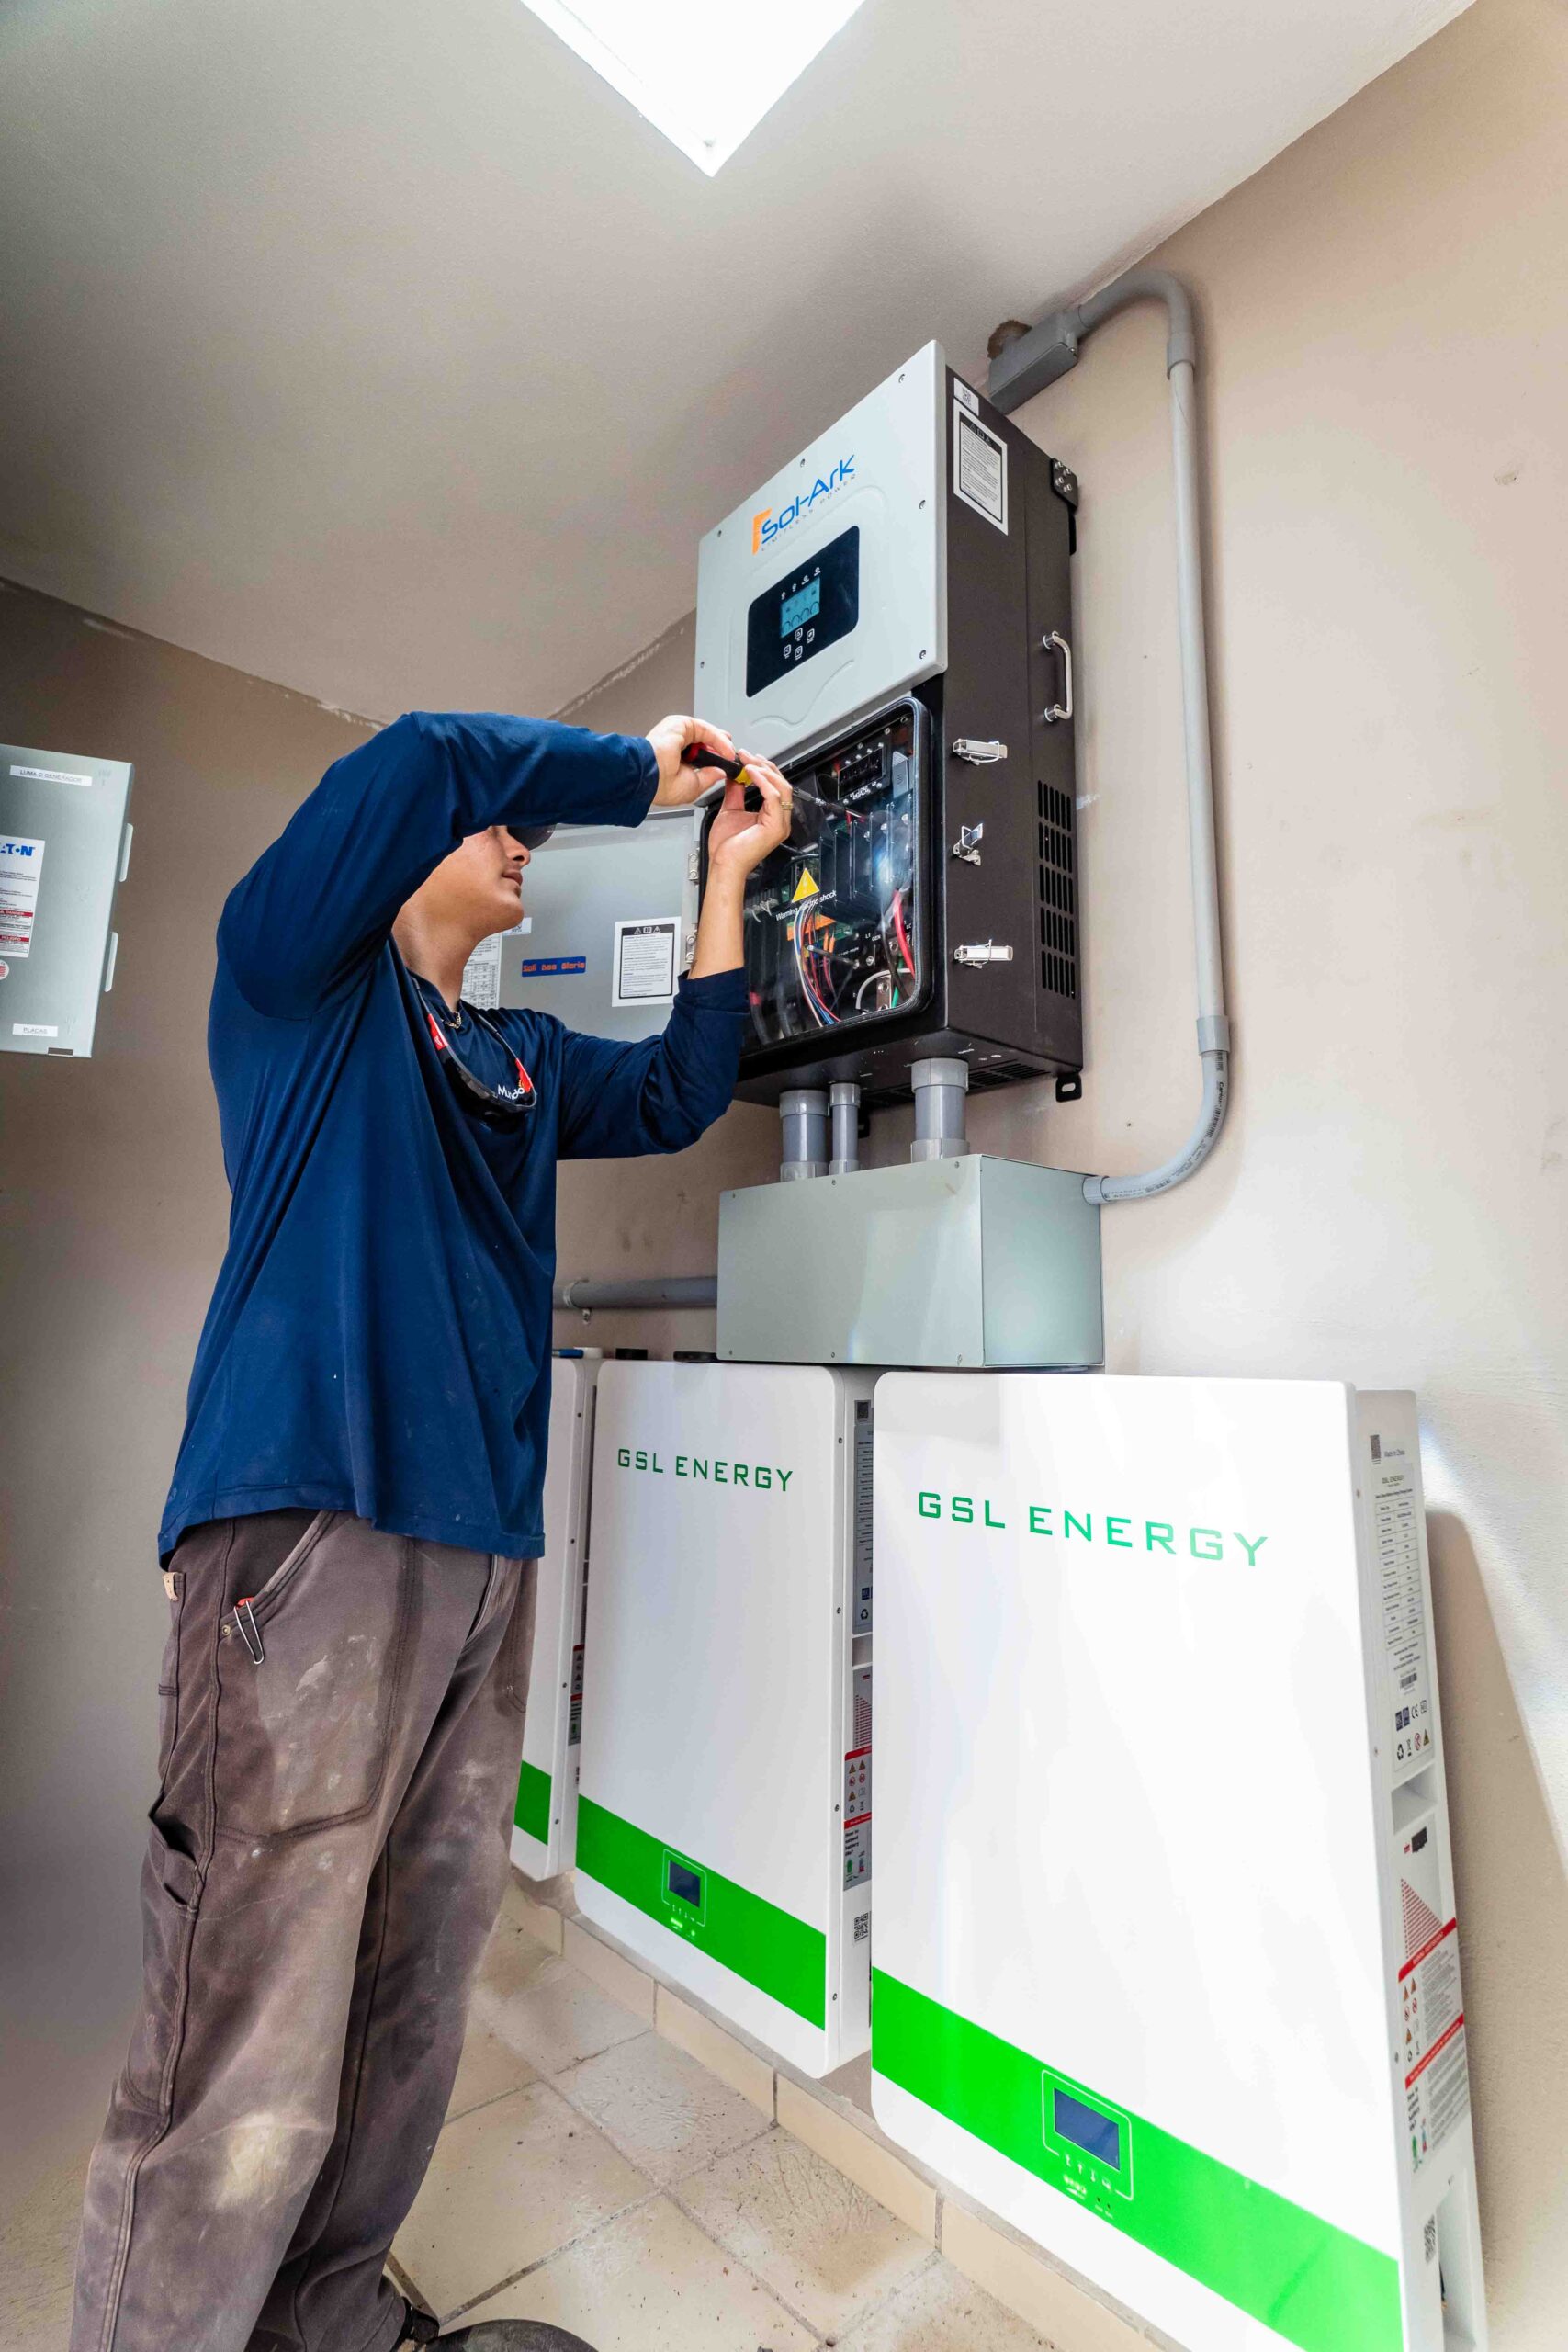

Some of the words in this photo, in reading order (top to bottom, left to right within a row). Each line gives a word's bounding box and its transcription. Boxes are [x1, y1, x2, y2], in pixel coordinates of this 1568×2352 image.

[761, 454, 855, 544] Sol-Ark
[775, 906, 798, 921] Warning
[819, 889, 837, 903] shock
[617, 1448, 663, 1474] GSL
[675, 1455, 794, 1492] ENERGY
[919, 1491, 1006, 1530] GSL
[1028, 1505, 1269, 1567] ENERGY
